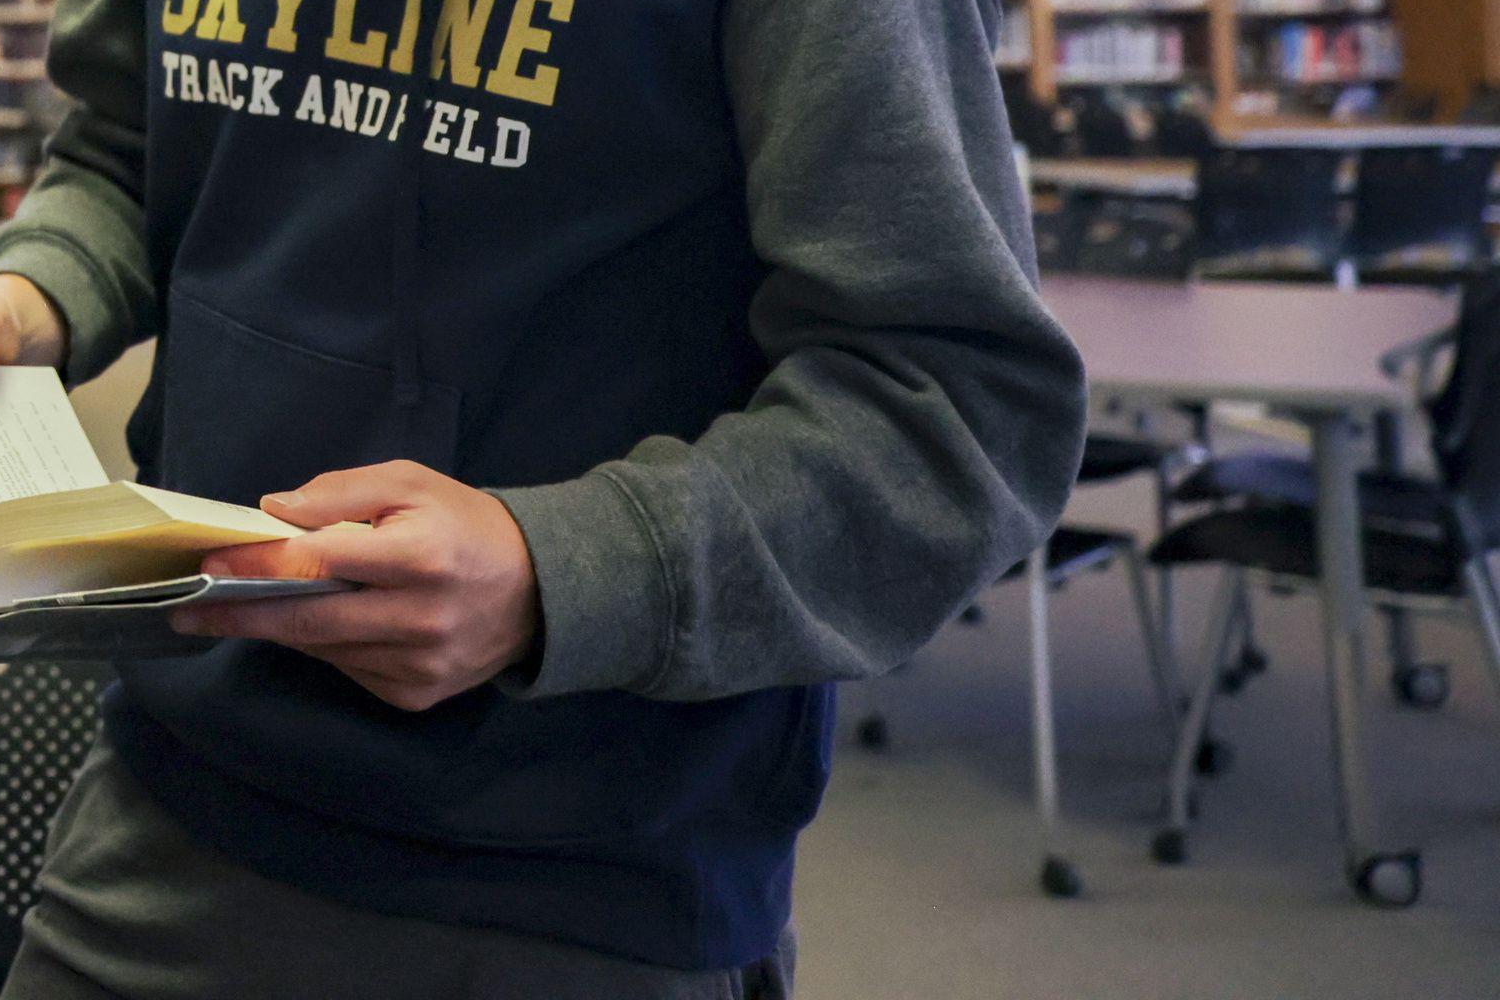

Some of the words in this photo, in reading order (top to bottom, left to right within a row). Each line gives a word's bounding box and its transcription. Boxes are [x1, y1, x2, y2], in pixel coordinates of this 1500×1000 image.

[162, 50, 284, 116] TRACK
[295, 74, 391, 137] AND
[388, 94, 531, 168] ELD
